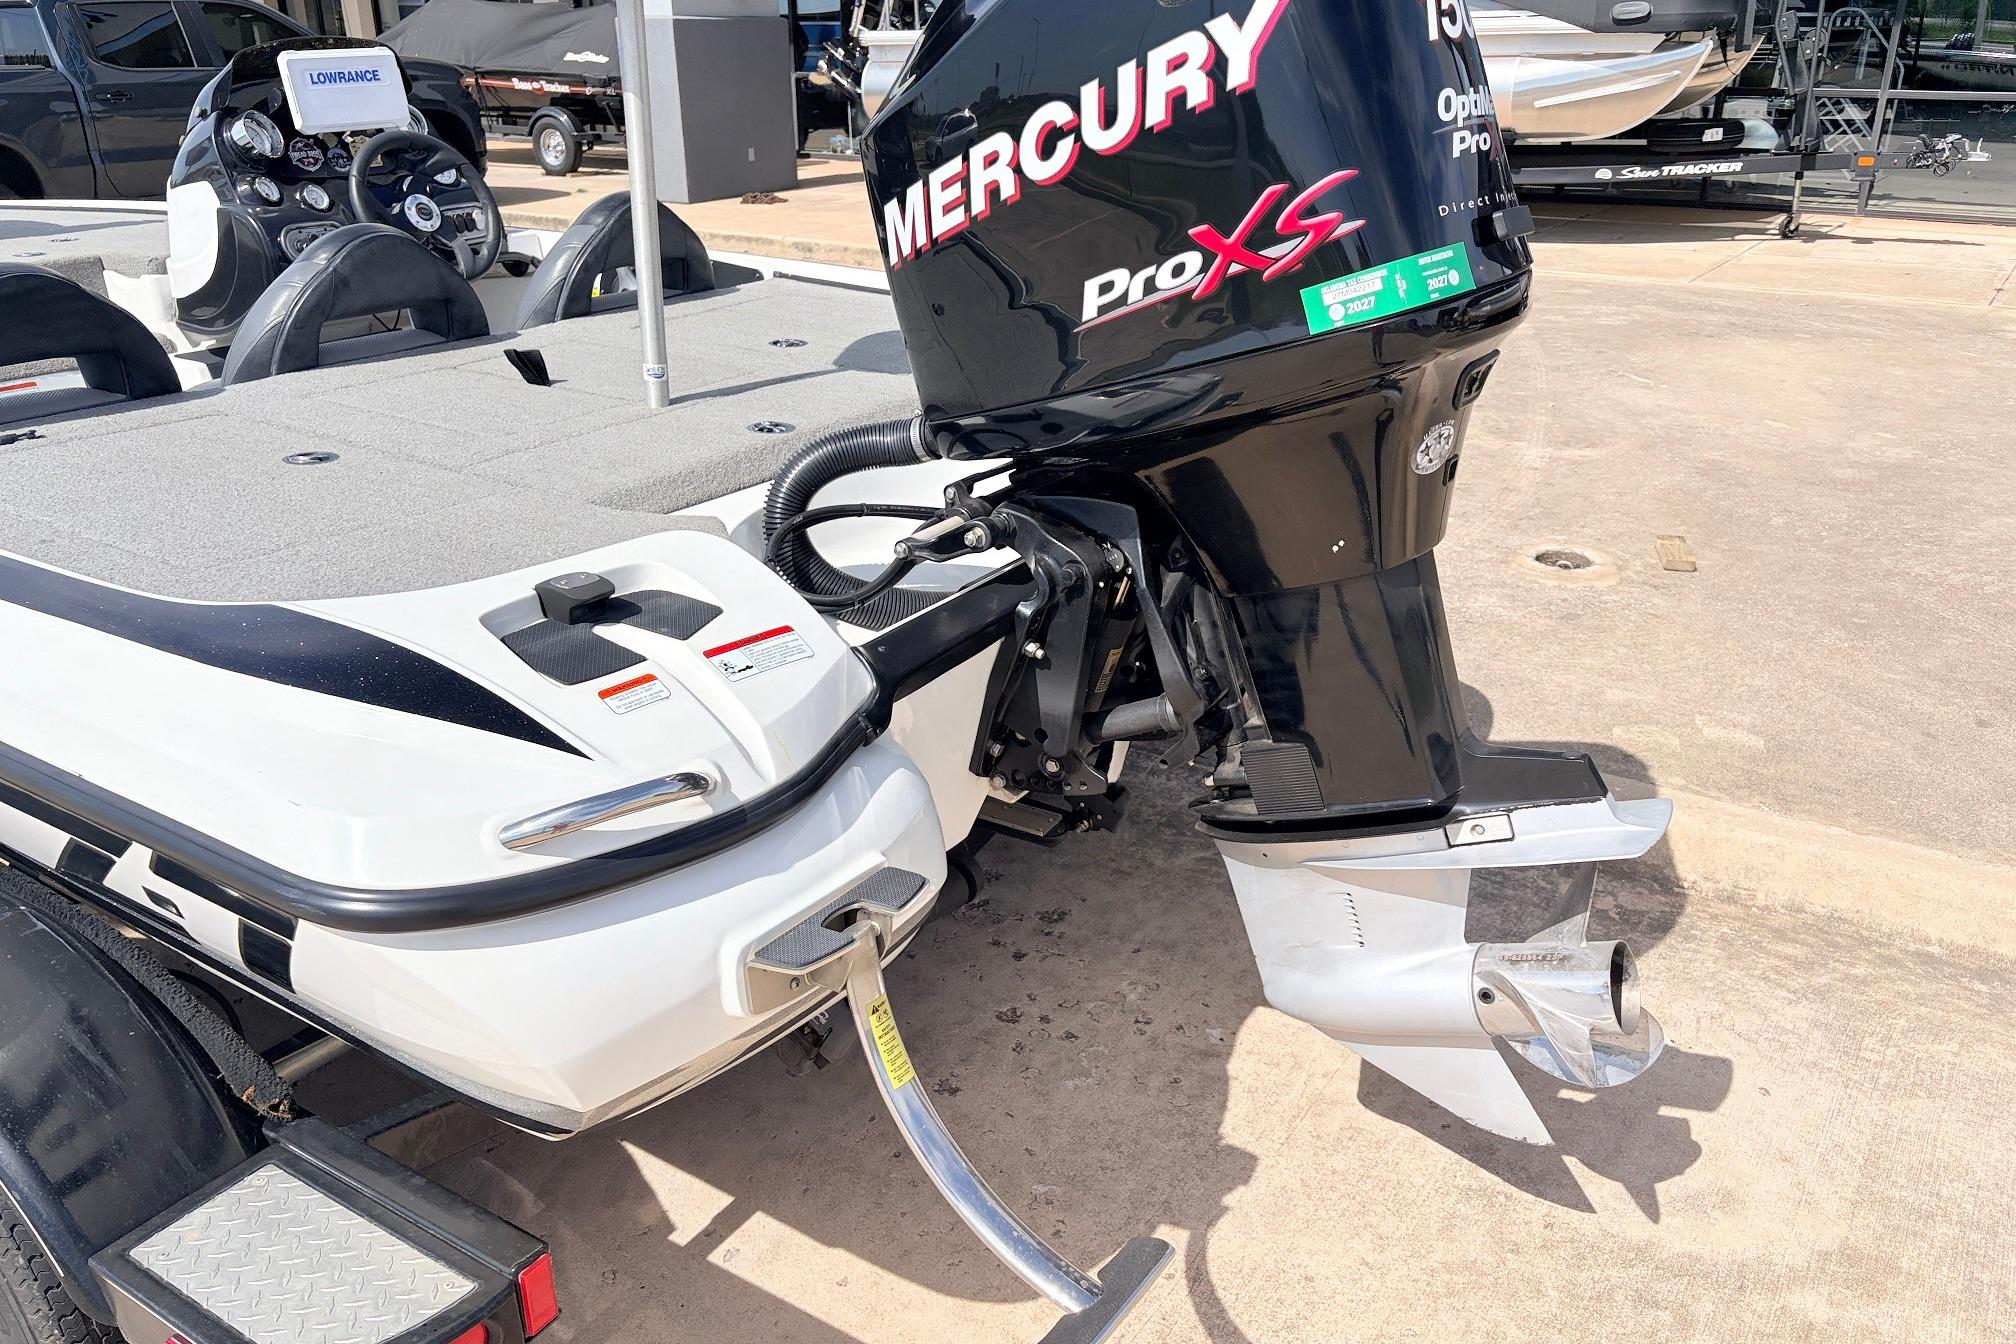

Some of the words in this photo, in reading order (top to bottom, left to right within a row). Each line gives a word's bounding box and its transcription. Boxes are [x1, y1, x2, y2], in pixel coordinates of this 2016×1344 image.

[309, 69, 381, 85] LOWRANCE
[883, 0, 1289, 269] MERCURY
[1616, 166, 1660, 179] Sun
[1661, 161, 1744, 177] TRACKER
[1438, 195, 1490, 217] Direct
[1426, 273, 1448, 291] 2027
[1345, 295, 1376, 315] 2027
